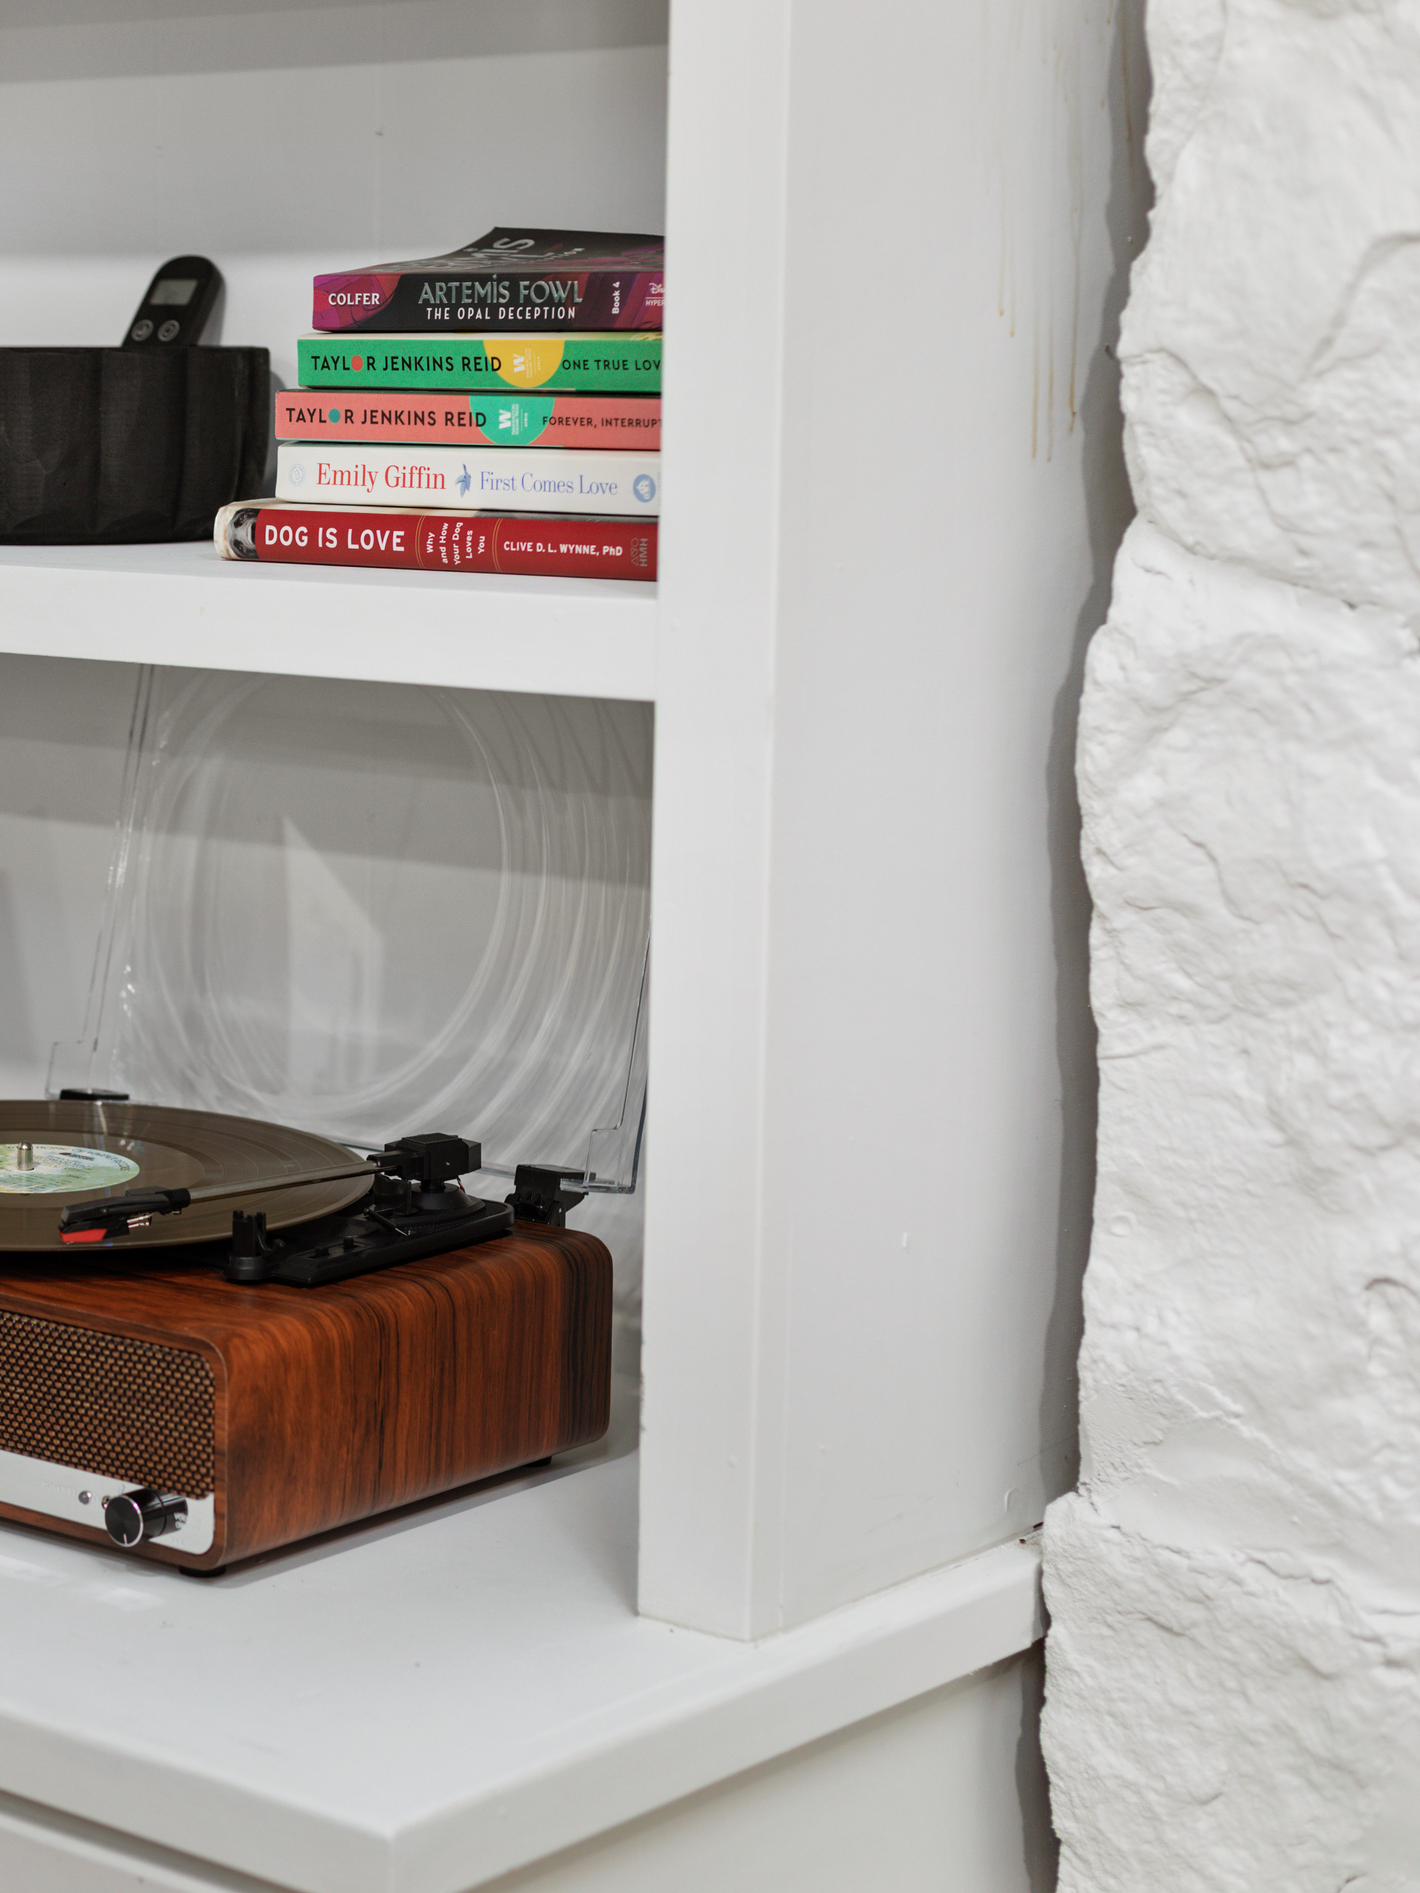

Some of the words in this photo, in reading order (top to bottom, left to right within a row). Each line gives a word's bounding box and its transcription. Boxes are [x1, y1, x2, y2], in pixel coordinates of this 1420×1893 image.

[328, 292, 381, 306] COLFER
[417, 274, 510, 304] ARTEMIS
[519, 280, 583, 303] FOWL
[611, 290, 620, 314] Book
[426, 307, 450, 320] THE
[457, 307, 491, 320] OPAL
[498, 306, 576, 320] DECEPTION
[382, 355, 454, 372] JENKINS
[462, 356, 502, 372] REID
[562, 359, 590, 371] ONE
[594, 359, 629, 371] TRUE
[635, 359, 662, 371] LOV
[361, 409, 437, 426] JENKINS
[444, 411, 487, 428] REID
[542, 416, 597, 429] FOREVER,
[316, 462, 379, 493] Emily
[384, 464, 447, 490] Giffin
[480, 471, 518, 491] First
[521, 472, 574, 493] Comes
[579, 474, 618, 495] Love
[265, 525, 308, 547] DOG
[318, 527, 338, 549] IS
[347, 528, 405, 552] LOVE
[439, 522, 449, 543] How
[452, 522, 463, 541] Dog
[426, 532, 435, 553] Why
[465, 530, 473, 559] Loves
[477, 536, 485, 554] You
[503, 541, 533, 552] CLIVE
[536, 542, 546, 553] D.
[547, 543, 557, 553] L.
[559, 543, 600, 557] WYNNE,
[602, 545, 623, 556] PhD
[639, 538, 648, 567] HMH
[439, 546, 448, 564] and
[453, 543, 461, 565] Your
